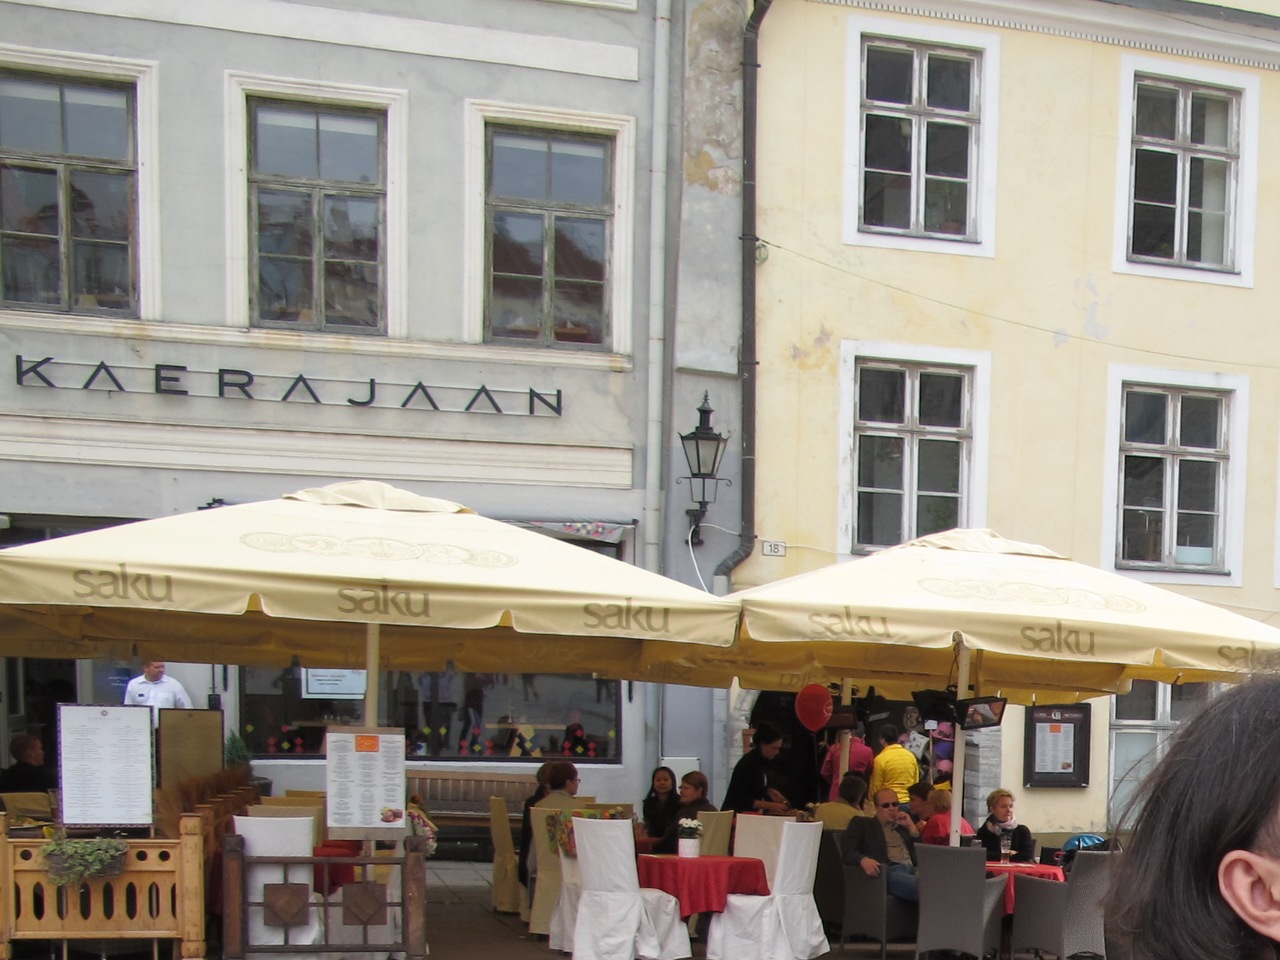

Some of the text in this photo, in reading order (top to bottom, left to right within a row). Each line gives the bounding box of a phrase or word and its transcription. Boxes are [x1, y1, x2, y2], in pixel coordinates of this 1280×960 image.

[15, 354, 563, 416] KAERAJAAN
[768, 543, 780, 554] 18
[72, 563, 174, 603] saku
[338, 579, 431, 618] saku
[583, 597, 671, 633] saku
[808, 605, 891, 638] saku
[1020, 620, 1096, 656] saku
